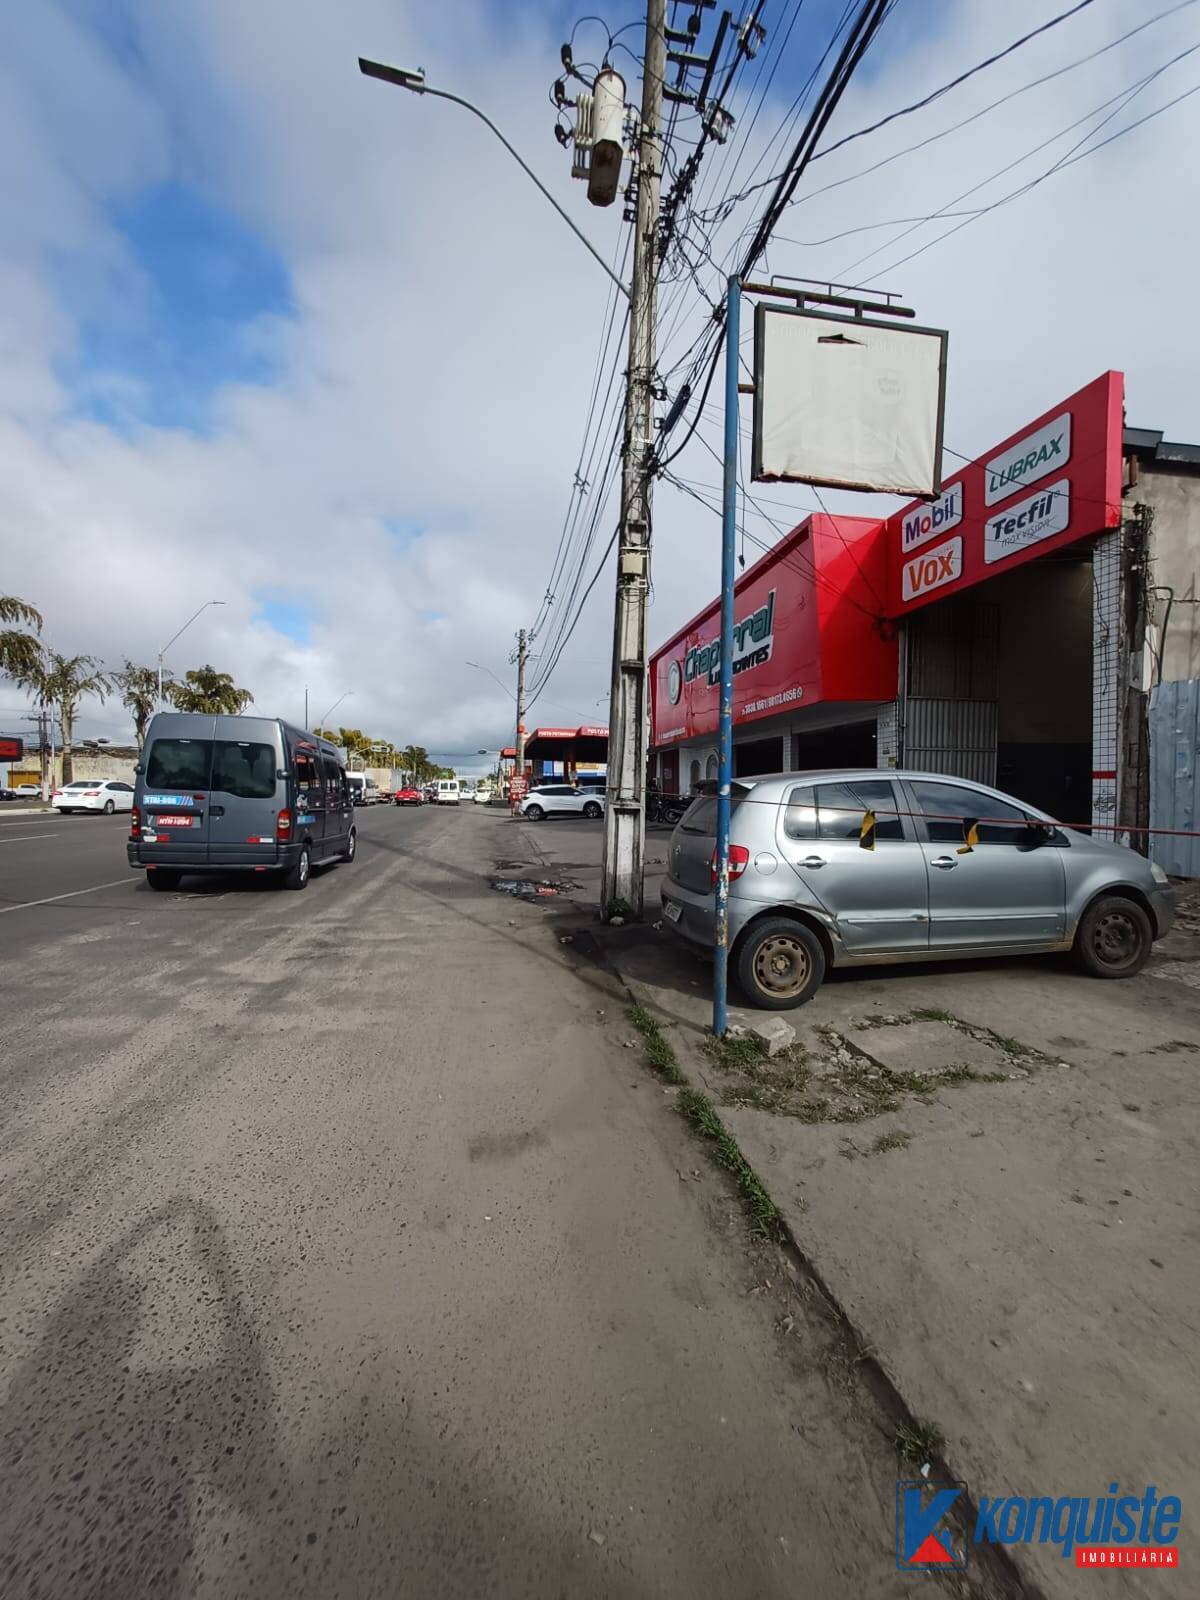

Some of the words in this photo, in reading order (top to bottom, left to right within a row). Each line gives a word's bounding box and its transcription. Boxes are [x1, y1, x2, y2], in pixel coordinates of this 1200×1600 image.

[990, 434, 1064, 493] LUBRAX
[906, 494, 954, 544] Mobil
[992, 492, 1054, 540] Tecfil
